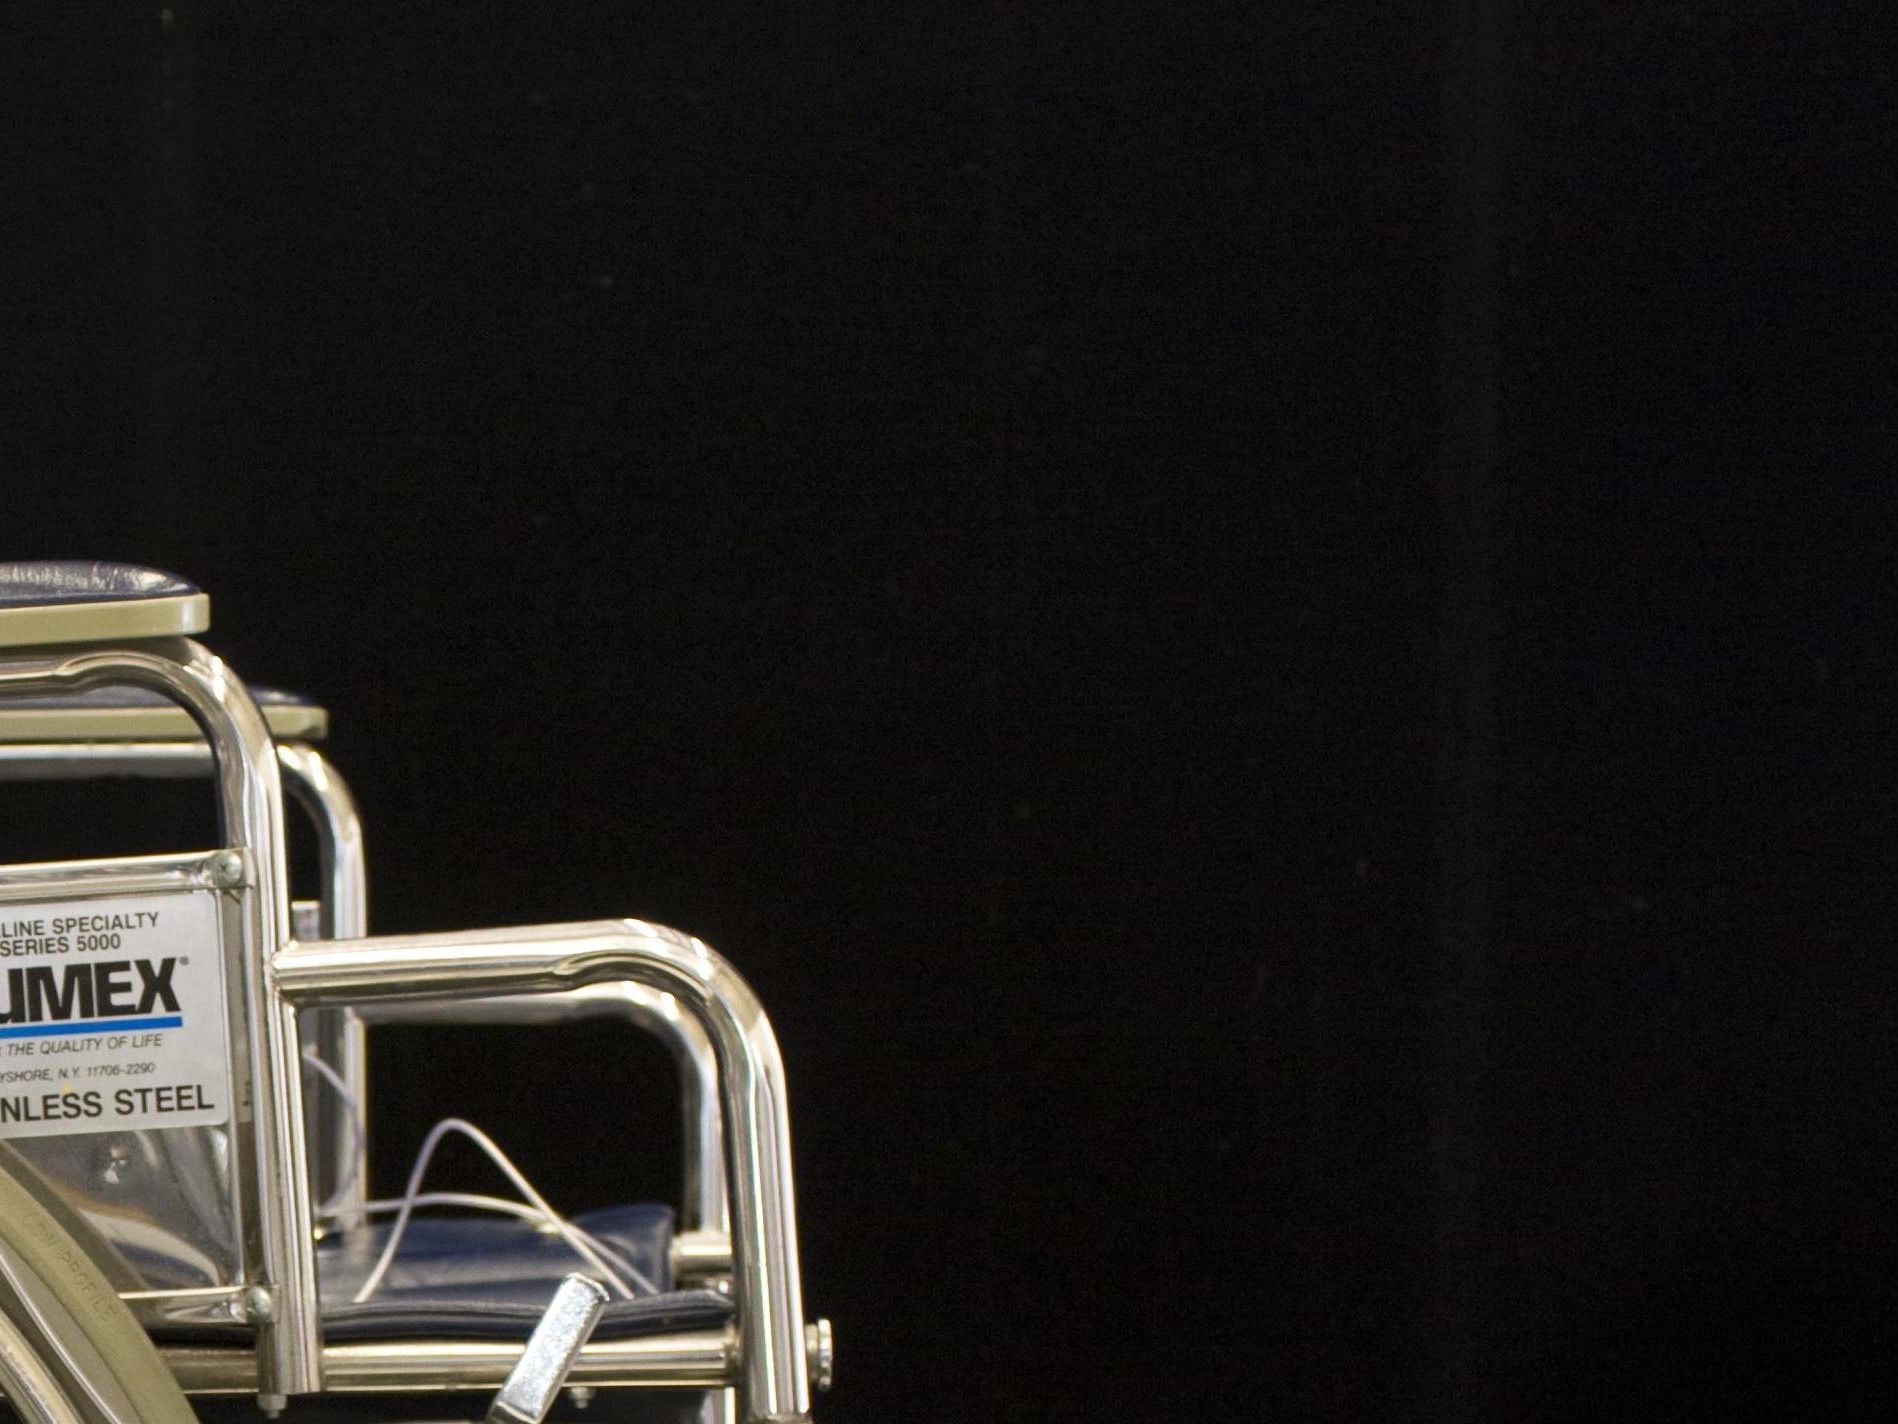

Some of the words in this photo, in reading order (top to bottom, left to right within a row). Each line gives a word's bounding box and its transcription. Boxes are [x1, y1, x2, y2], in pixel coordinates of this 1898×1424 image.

[51, 912, 159, 935] SPECIALTY
[0, 937, 69, 957] SERIES
[77, 933, 121, 952] 5000
[7, 1042, 35, 1057] THE
[40, 1037, 103, 1055] QUALITY
[107, 1036, 129, 1050] OF
[132, 1033, 164, 1048] LIFE
[114, 1084, 215, 1116] STEEL
